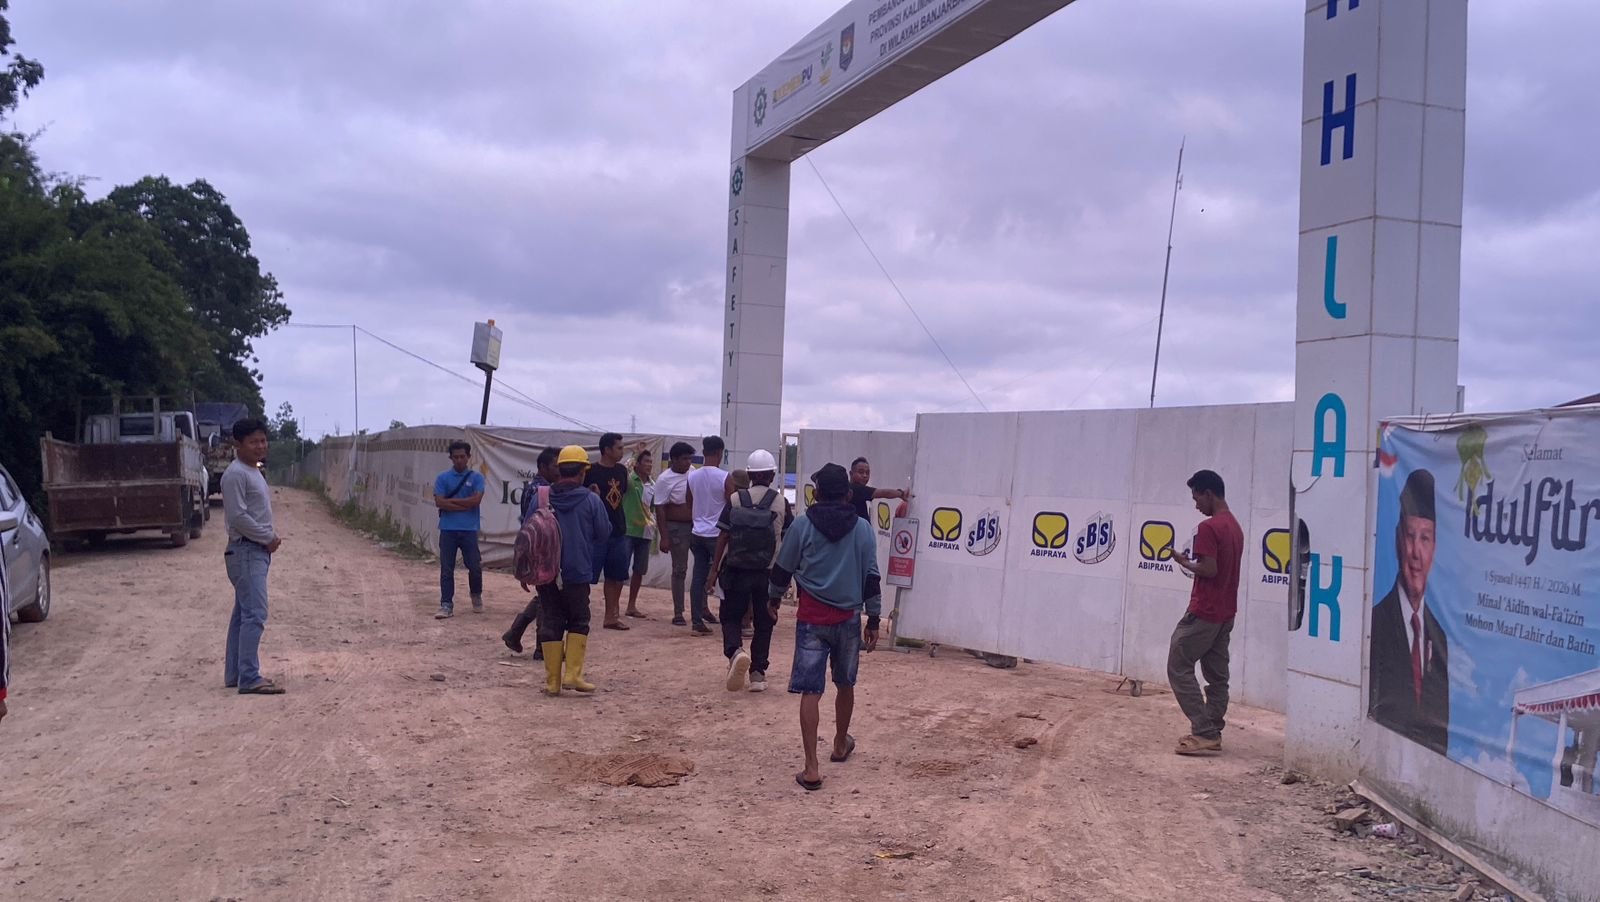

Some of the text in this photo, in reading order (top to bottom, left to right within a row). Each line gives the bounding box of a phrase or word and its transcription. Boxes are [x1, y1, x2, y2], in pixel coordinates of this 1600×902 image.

[888, 20, 920, 51] WILAYAH
[728, 209, 740, 368] SAFETY
[1521, 443, 1563, 463] Selamat
[967, 518, 996, 547] SBS
[1076, 522, 1109, 555] SBS
[928, 541, 960, 551] ABIPRAYA
[1030, 549, 1067, 559] ABIPRAYA
[1138, 561, 1174, 573] ABIPRAYA
[1261, 574, 1290, 586] ABIPR
[1489, 570, 1513, 586] Syawal
[1533, 576, 1540, 590] H
[1547, 580, 1570, 595] 2026
[1572, 583, 1581, 596] M
[1477, 592, 1502, 610] Minal
[1465, 613, 1596, 655] Mohon Maaf Lahir dan Batin
